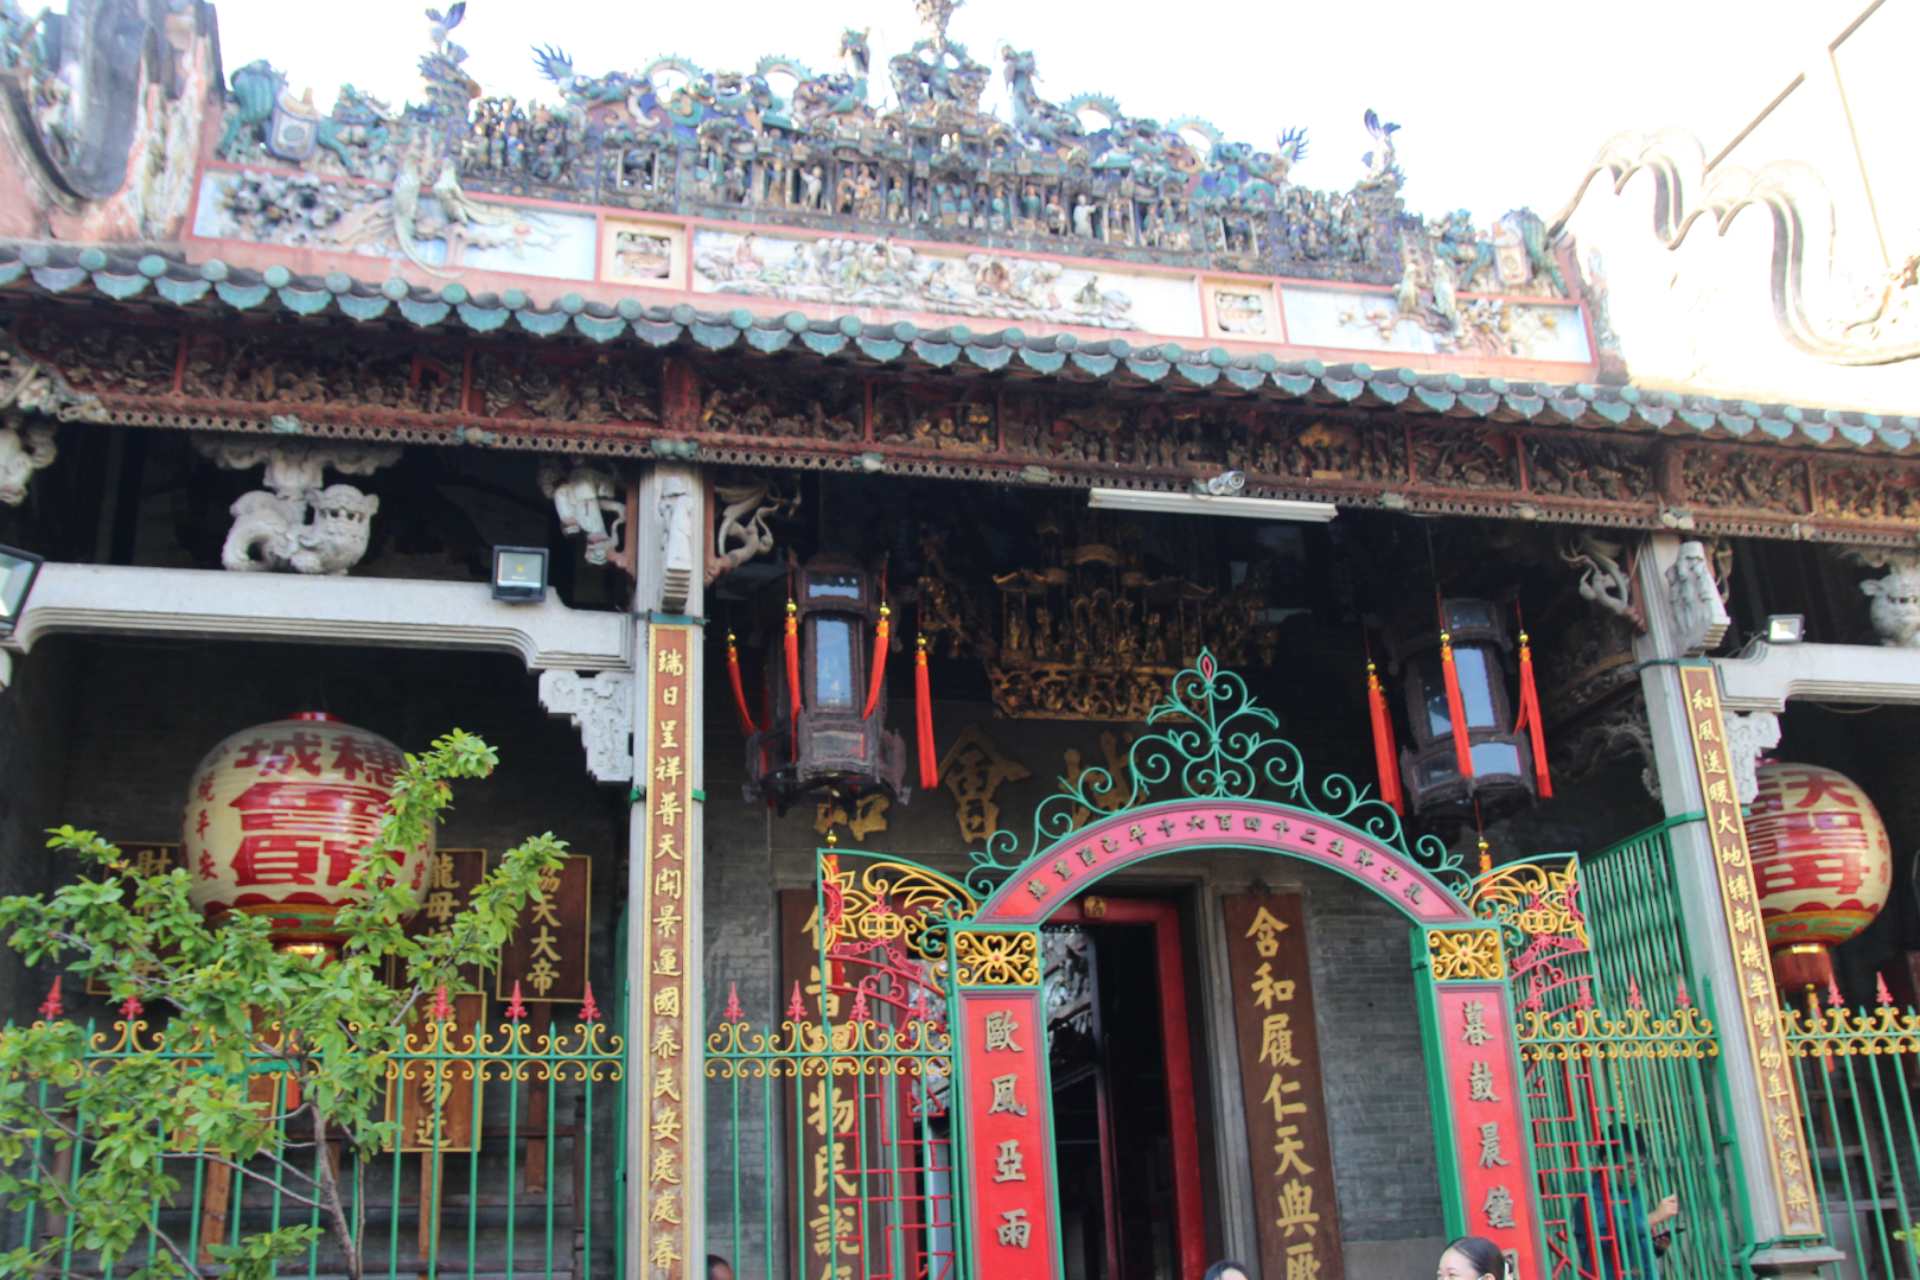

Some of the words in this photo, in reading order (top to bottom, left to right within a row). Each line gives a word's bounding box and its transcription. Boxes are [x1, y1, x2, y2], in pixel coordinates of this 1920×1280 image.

[984, 1009, 1032, 1249] 歐風亞雨
[1462, 1000, 1521, 1280] 暮鼓晨鐘
